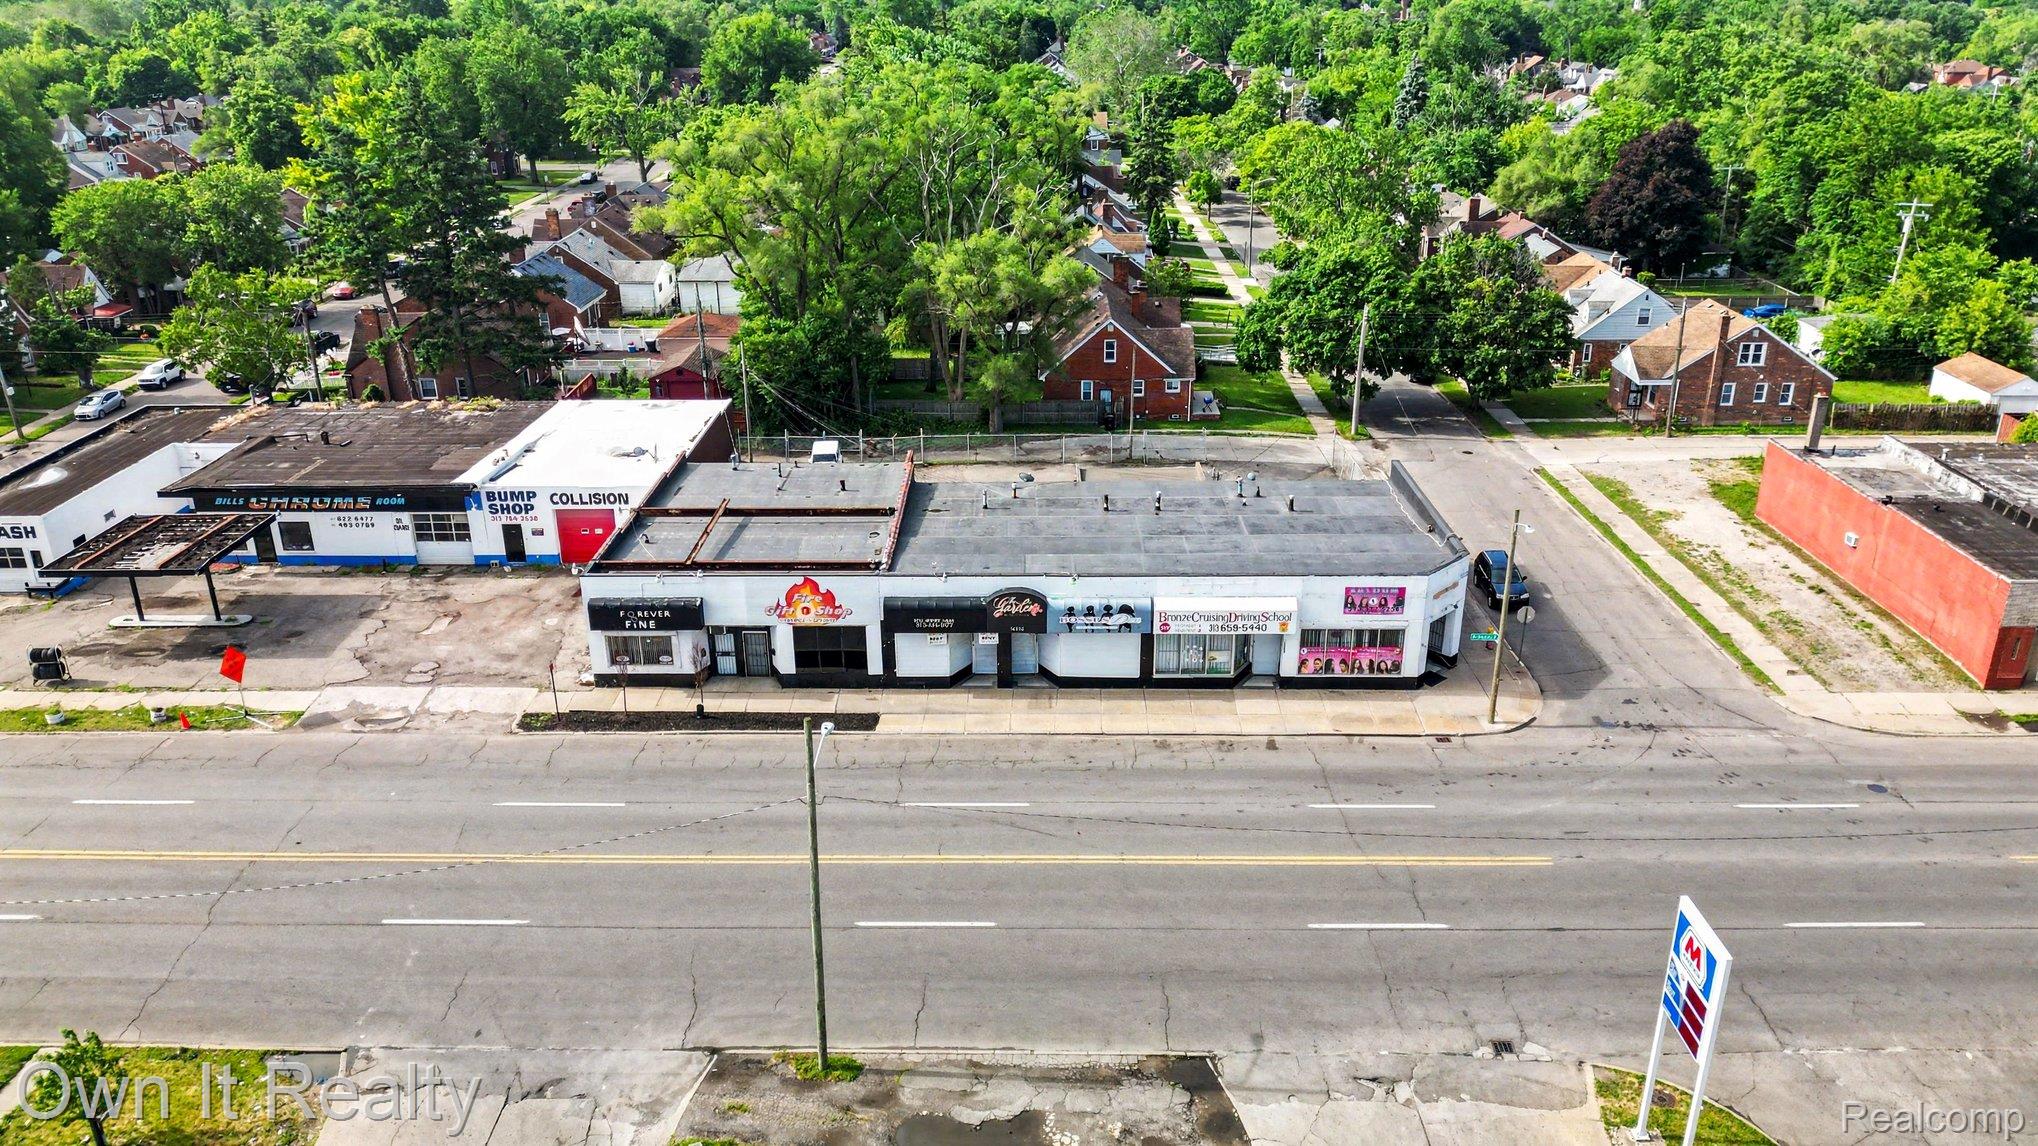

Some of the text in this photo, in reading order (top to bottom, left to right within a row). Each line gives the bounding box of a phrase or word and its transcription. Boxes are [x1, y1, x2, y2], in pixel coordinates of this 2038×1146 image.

[485, 491, 537, 503] BUMP
[550, 492, 629, 506] COLLISION
[215, 497, 405, 510] BILLS CHROME ROOM
[488, 503, 535, 515] SHOP
[792, 593, 823, 603] Fire
[620, 610, 671, 622] FOREVER
[765, 605, 853, 619] Gift Shop
[1220, 623, 1268, 632] 659-5440
[1684, 935, 1701, 972] M
